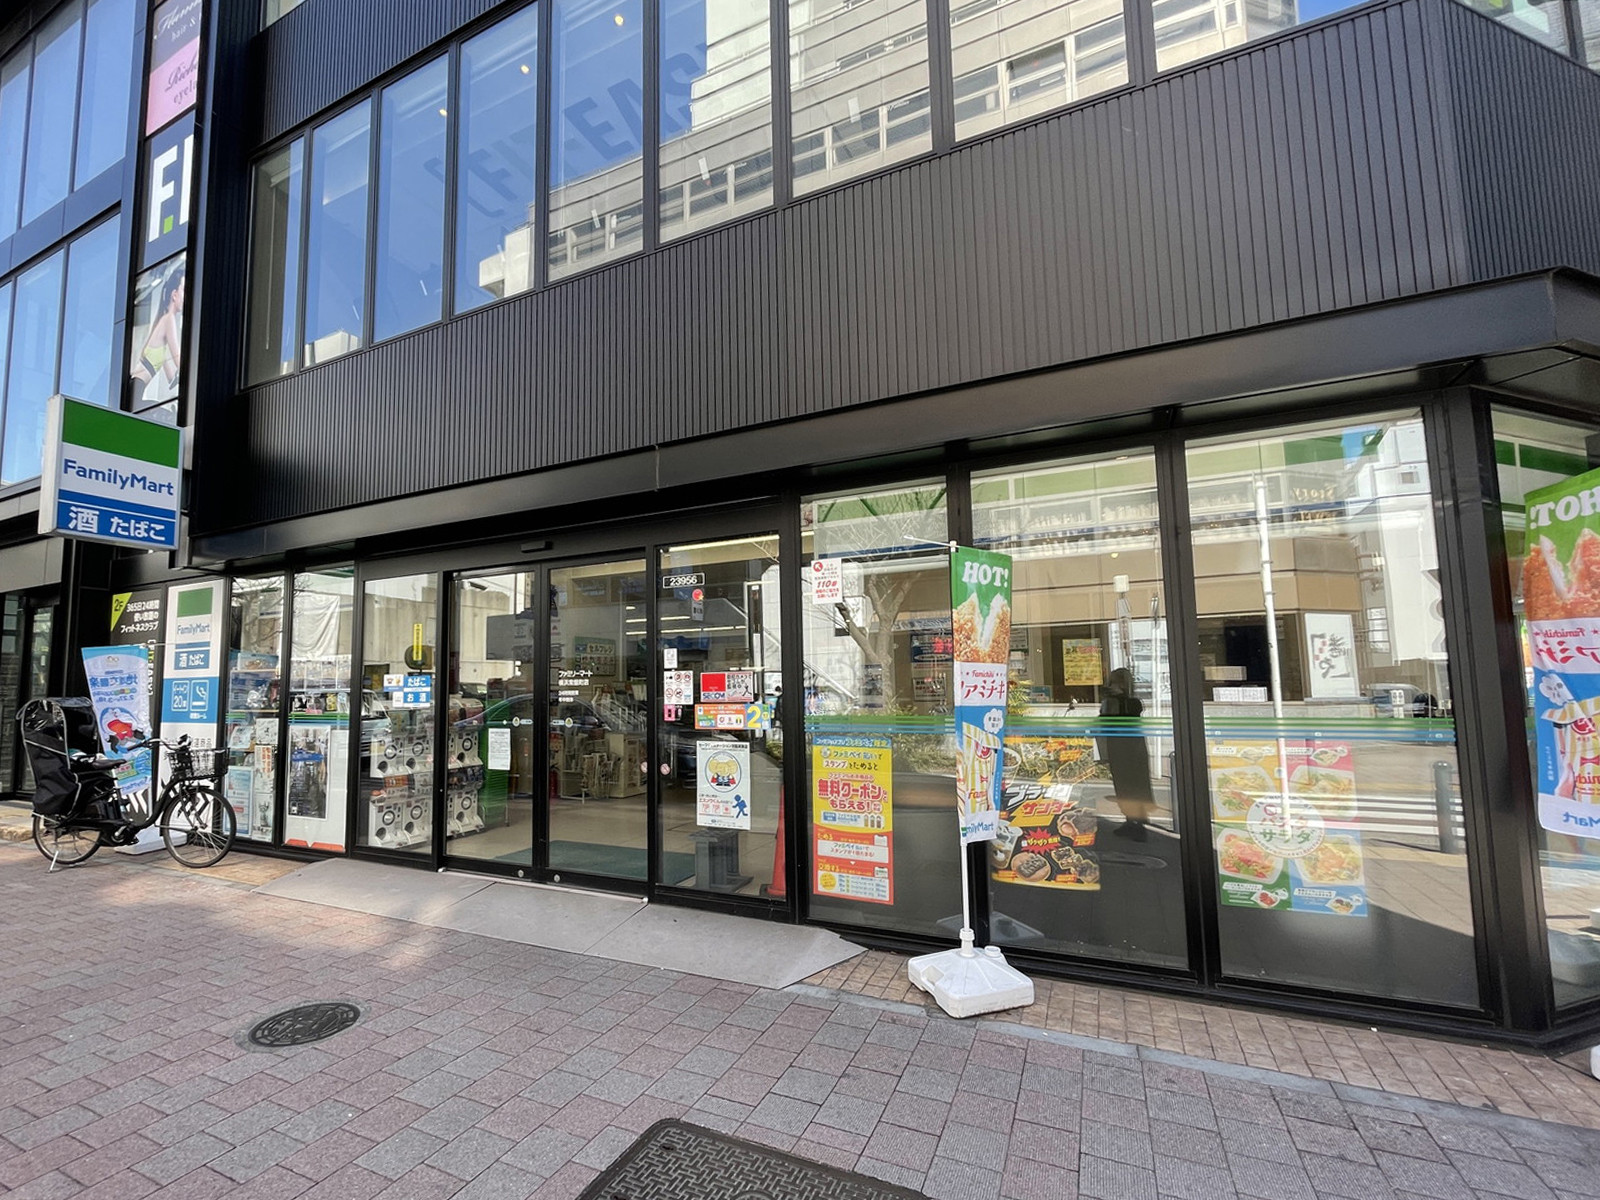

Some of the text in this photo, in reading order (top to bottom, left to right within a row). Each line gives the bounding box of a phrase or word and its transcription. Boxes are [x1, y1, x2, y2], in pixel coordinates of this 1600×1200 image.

[63, 458, 174, 496] FamilyMart
[68, 506, 165, 541] 酒 たばこ
[669, 576, 697, 586] 23956
[962, 561, 1009, 588] HOT!
[114, 598, 123, 612] 2F
[177, 623, 210, 636] FamilyMart
[407, 677, 427, 687] たばこ
[1022, 801, 1078, 816] サンダー
